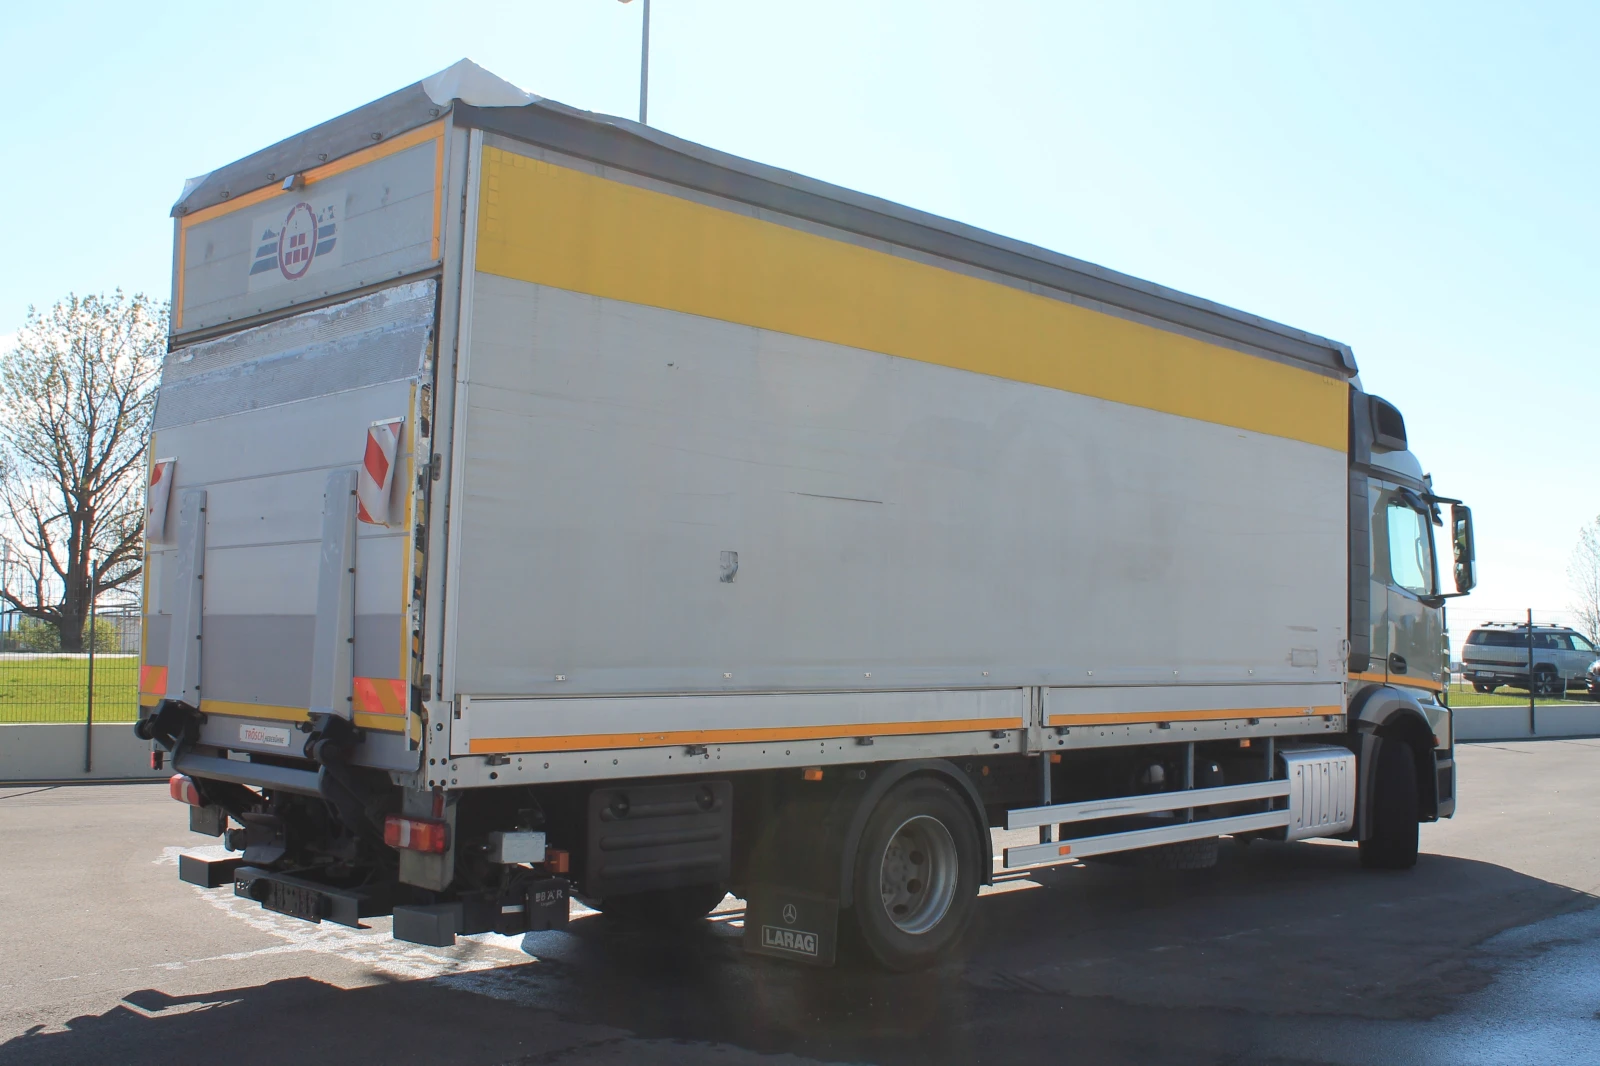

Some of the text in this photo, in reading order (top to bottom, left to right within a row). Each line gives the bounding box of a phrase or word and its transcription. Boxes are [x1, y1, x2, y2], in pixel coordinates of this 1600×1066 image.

[245, 728, 265, 741] TRÖSCH
[540, 889, 563, 902] BÄR
[765, 928, 815, 953] LARAG
